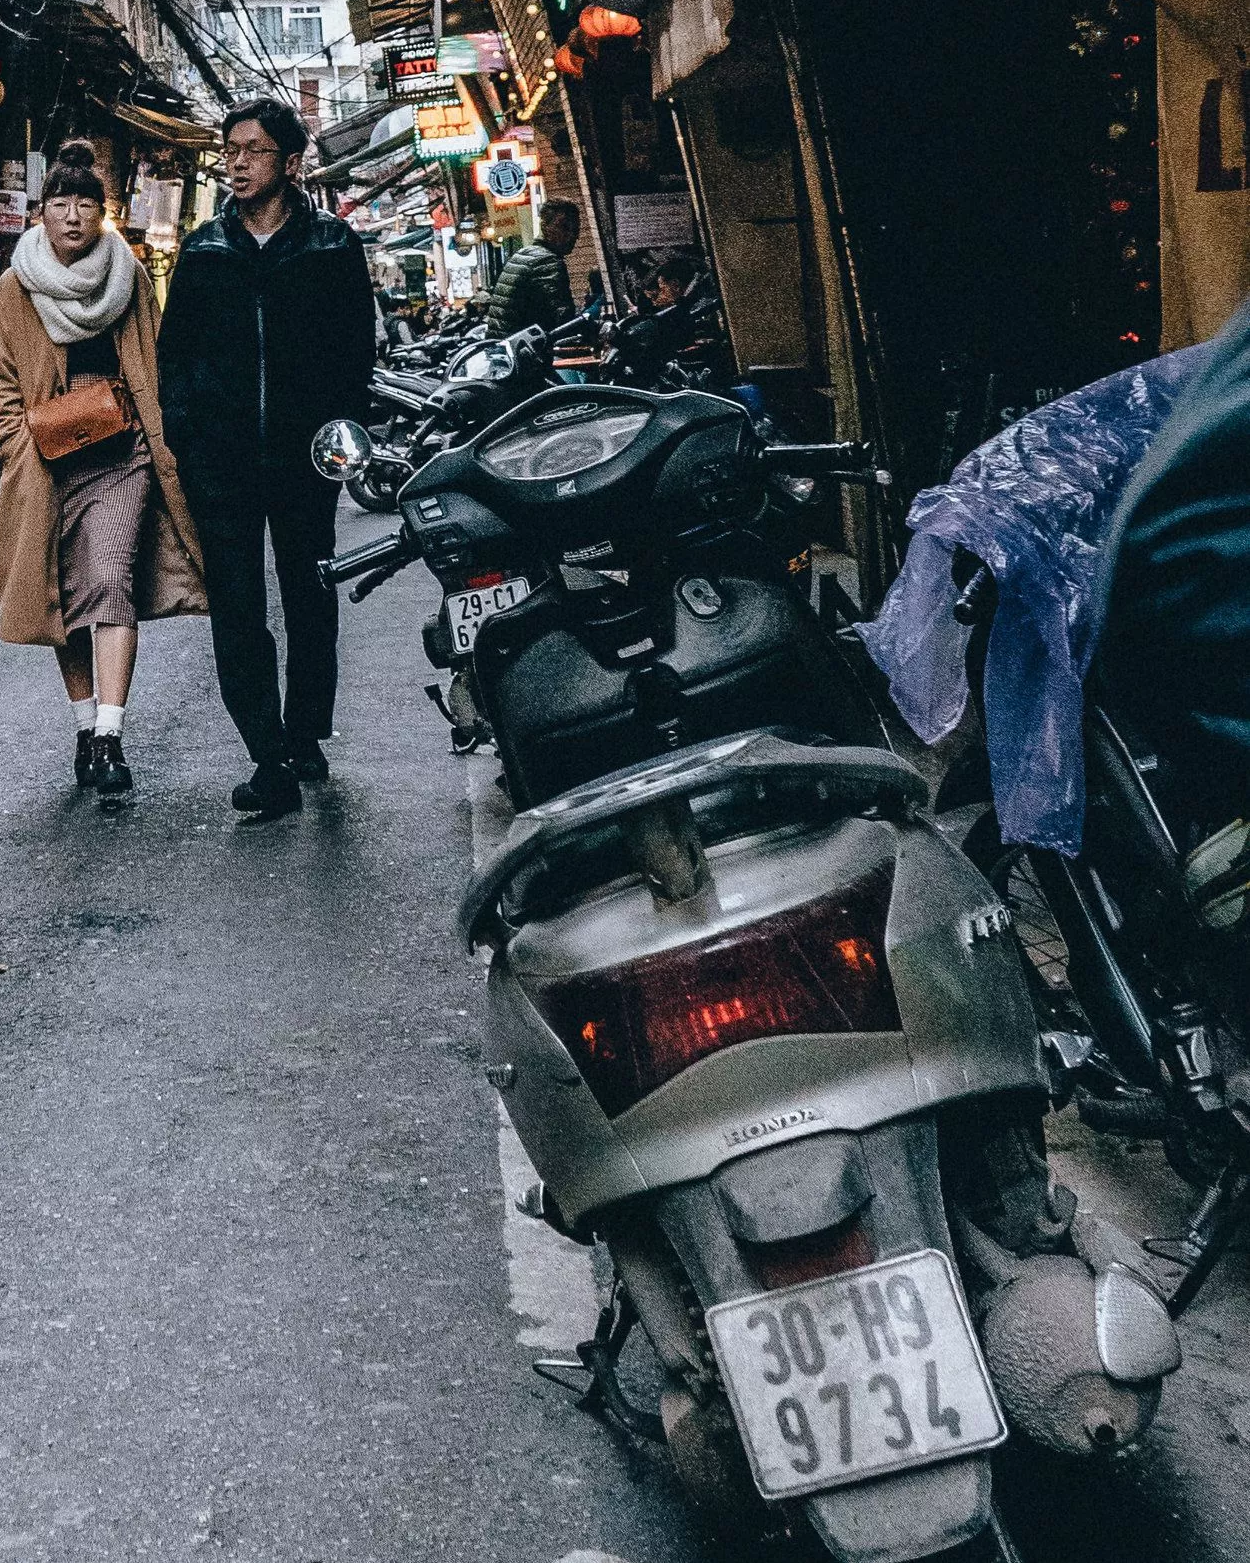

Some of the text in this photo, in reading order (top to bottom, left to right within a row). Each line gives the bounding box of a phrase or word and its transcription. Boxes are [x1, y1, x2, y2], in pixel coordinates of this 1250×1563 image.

[394, 59, 436, 75] TATT
[458, 585, 517, 621] 29-C1
[722, 1106, 827, 1148] HONDA
[744, 1273, 935, 1386] 30-H9
[775, 1361, 963, 1475] 9734
